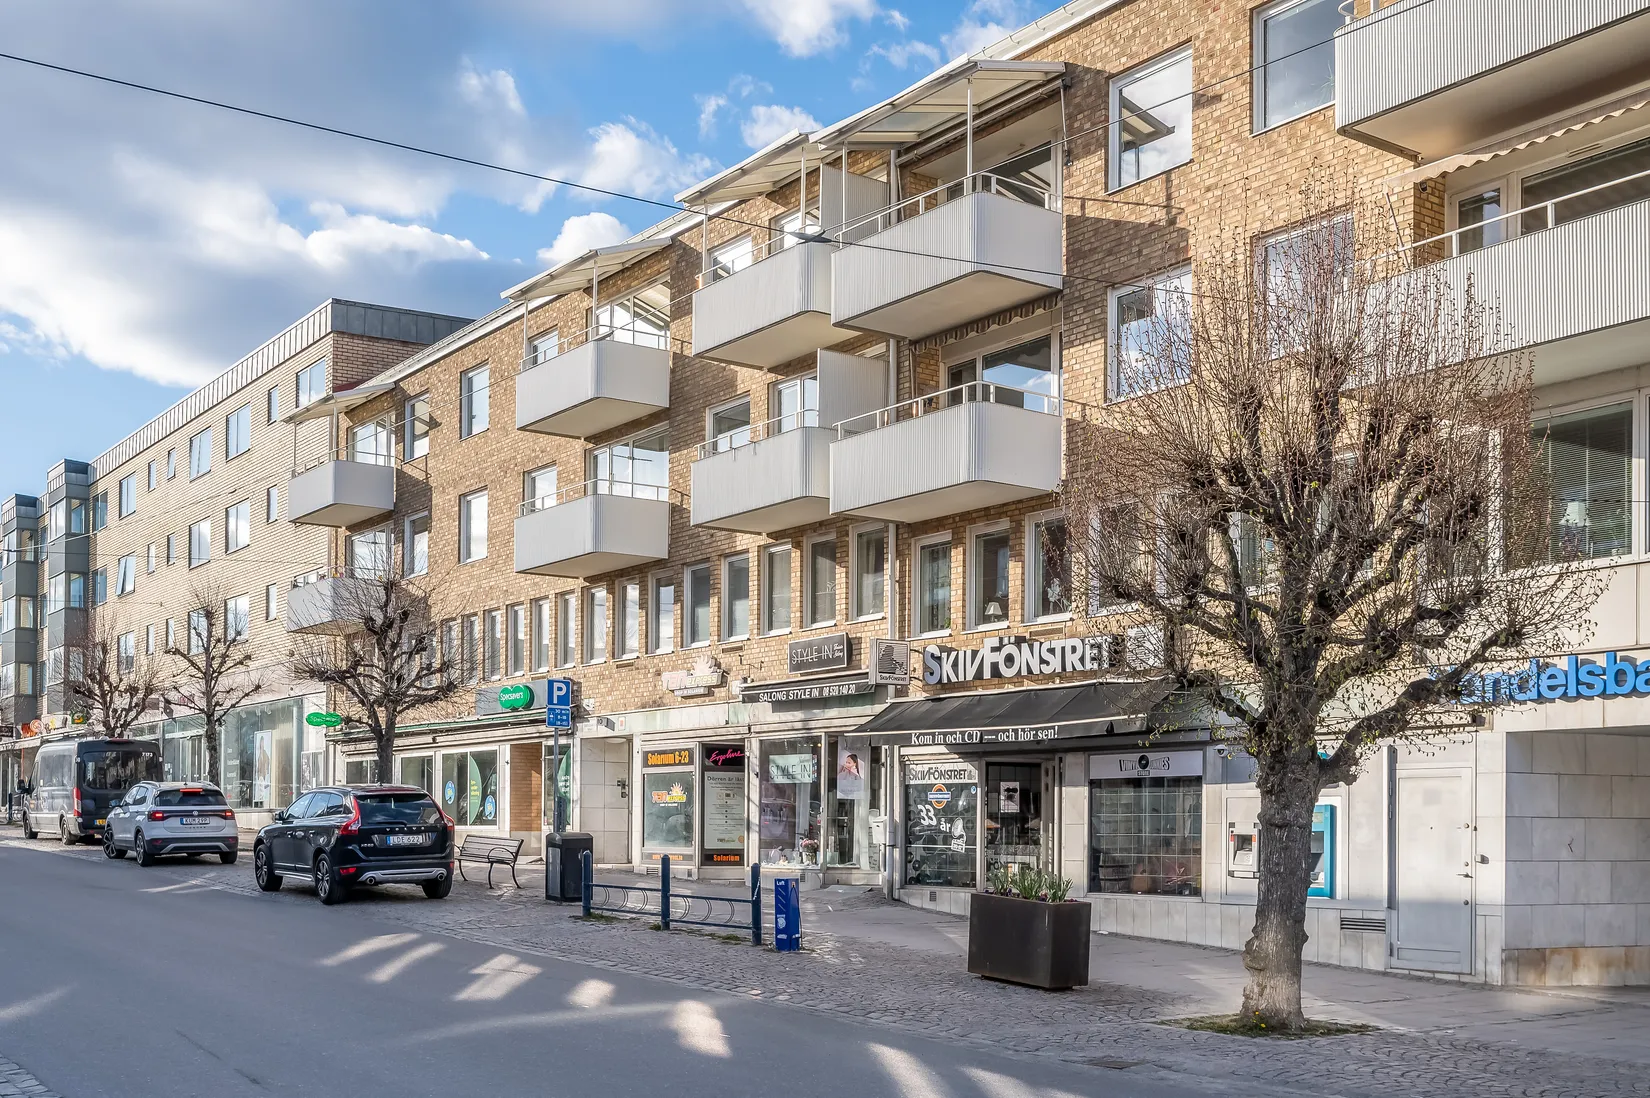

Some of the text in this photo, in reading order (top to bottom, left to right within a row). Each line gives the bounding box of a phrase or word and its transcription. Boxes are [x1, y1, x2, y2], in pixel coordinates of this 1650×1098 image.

[792, 644, 832, 664] STYLE IN
[924, 635, 1113, 685] SKIVFÖNSTRET
[1427, 652, 1650, 704] andelsba
[500, 692, 524, 701] Specsavers
[553, 682, 567, 704] P
[759, 691, 786, 702] SALONG
[789, 689, 811, 700] STYLE
[811, 687, 820, 698] IN
[911, 732, 933, 745] Kom
[935, 732, 944, 744] in
[947, 731, 963, 743] och
[964, 730, 980, 743] CD
[998, 729, 1016, 741] och
[1018, 728, 1035, 741] hör
[1037, 725, 1058, 740] sen!
[647, 750, 689, 765] Solarium 6-23
[769, 764, 811, 780] STYLE IN
[909, 766, 967, 781] SKIVFÖNSTRET
[917, 804, 938, 826] 33
[939, 817, 951, 833] år
[392, 836, 421, 844] LDE 622
[713, 854, 740, 862] Solarium
